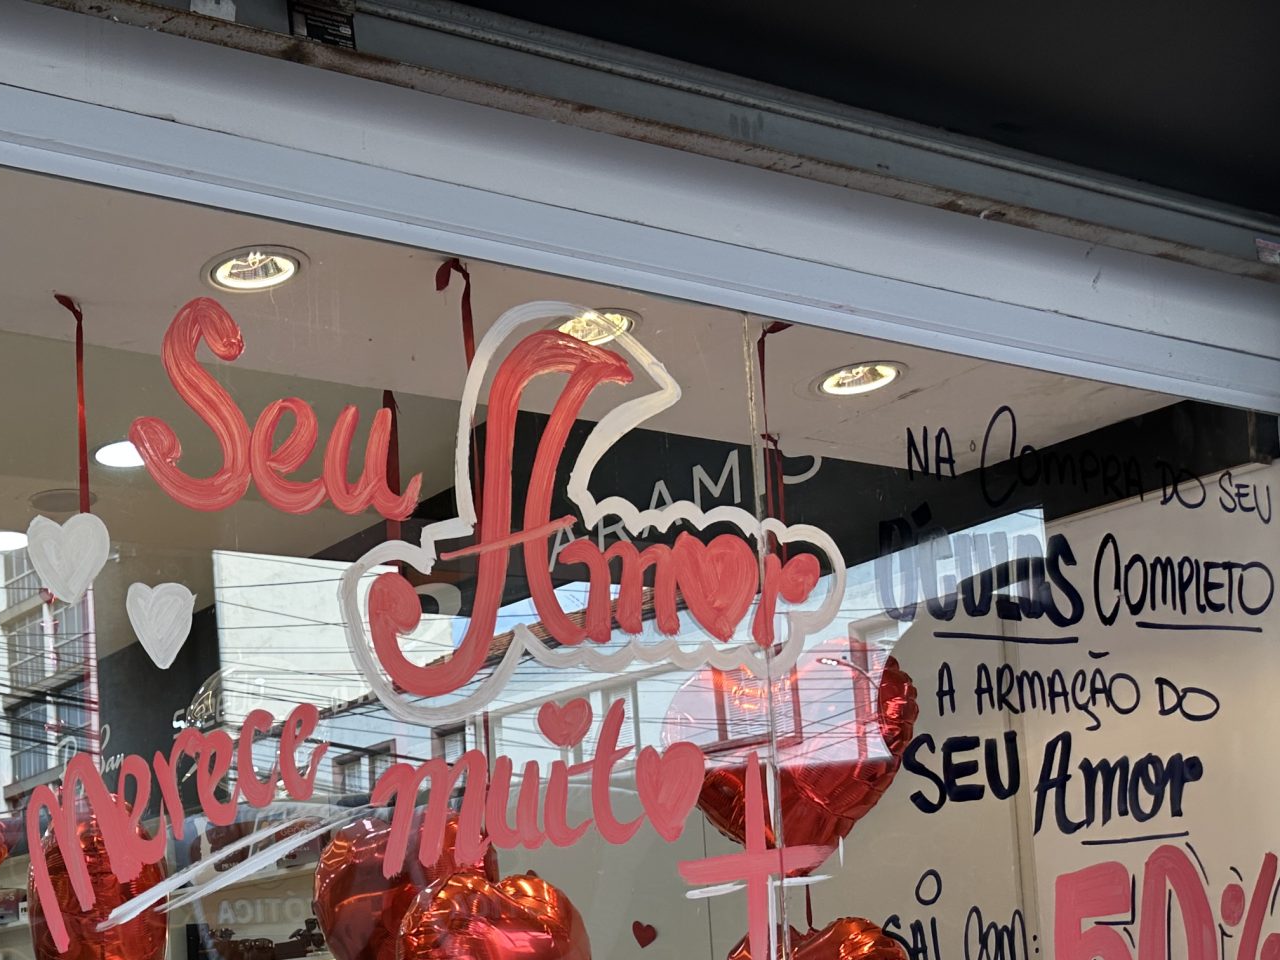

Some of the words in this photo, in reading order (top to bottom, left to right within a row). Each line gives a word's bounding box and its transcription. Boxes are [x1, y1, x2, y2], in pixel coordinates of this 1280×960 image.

[129, 297, 423, 521] Seu
[906, 426, 956, 481] NA
[1161, 466, 1206, 509] DO
[1218, 471, 1272, 524] SEU
[936, 662, 956, 716] A
[975, 650, 1141, 731] ARMAÇÃO
[1155, 677, 1220, 721] DO
[902, 730, 1020, 814] SEU
